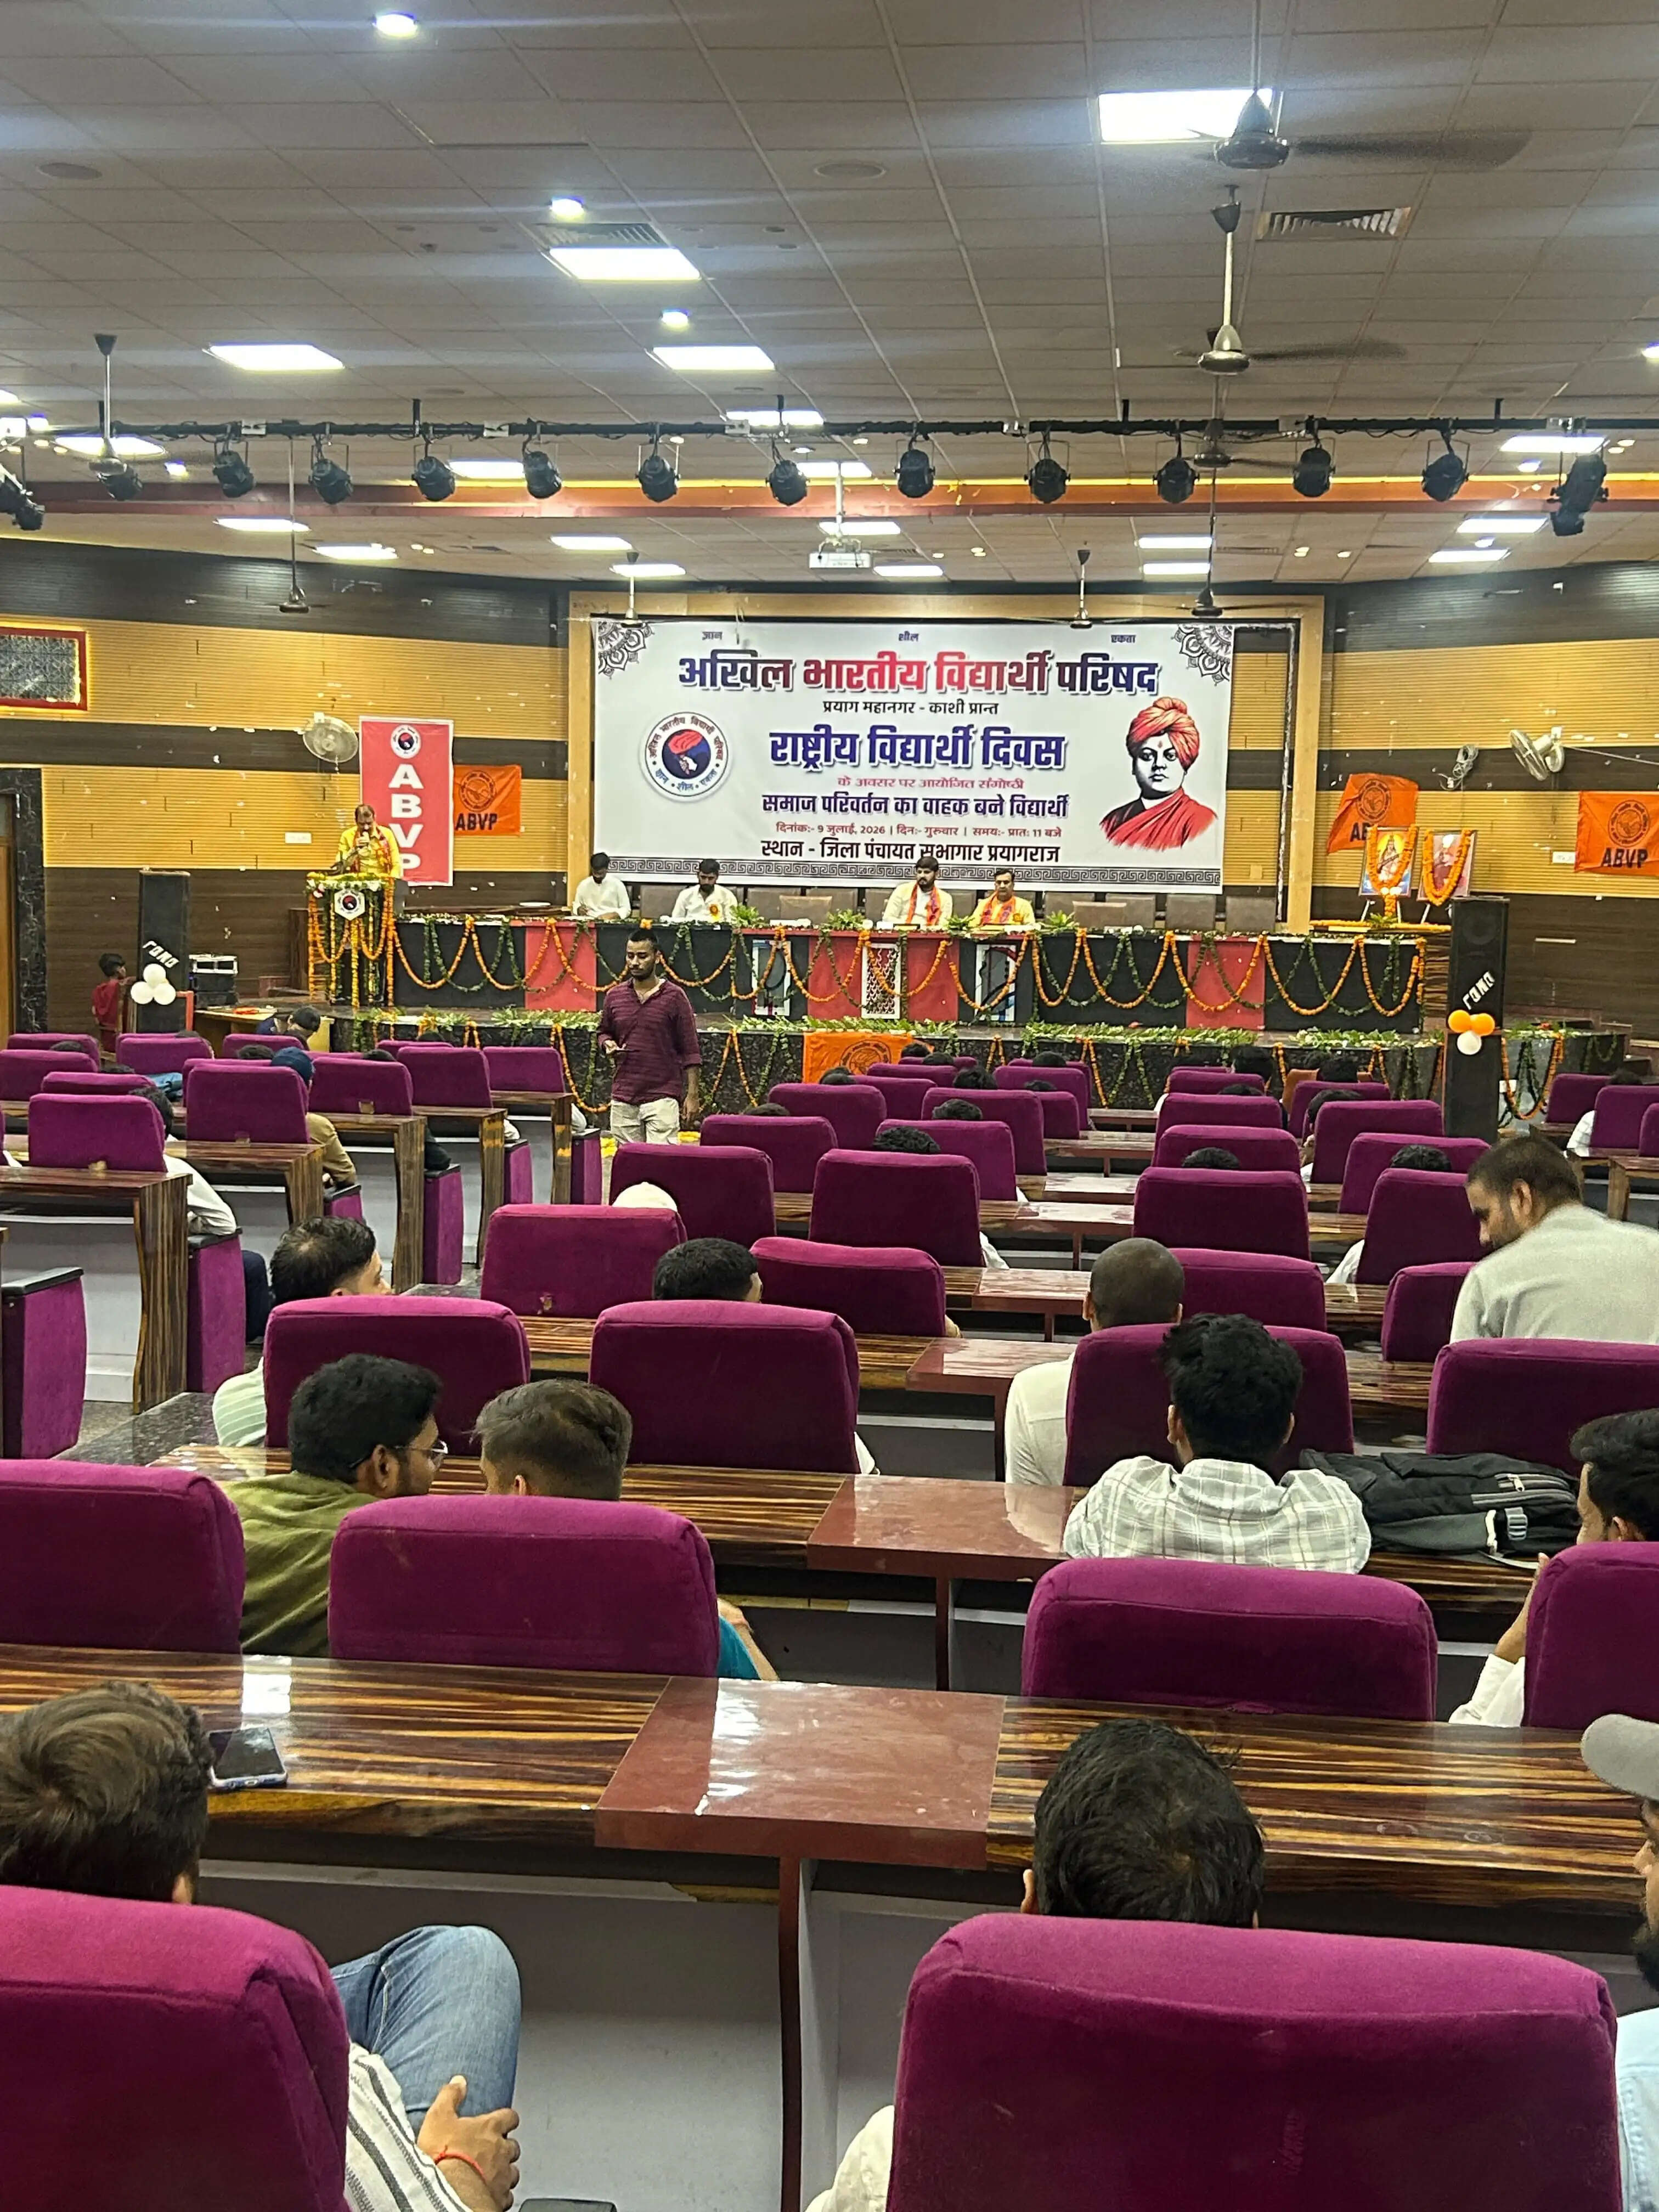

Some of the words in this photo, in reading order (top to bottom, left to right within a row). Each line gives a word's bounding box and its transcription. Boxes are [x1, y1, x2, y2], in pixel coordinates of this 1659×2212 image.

[898, 630, 919, 642] शील
[1111, 634, 1136, 644] एकता
[679, 649, 793, 689] अखिल
[803, 650, 927, 691] भारतीय
[934, 650, 1052, 692] विद्यार्थी
[1056, 653, 1159, 693] परिषद
[823, 701, 859, 714] प्रयाग
[862, 702, 915, 714] महानगर
[929, 698, 964, 714] काशी
[769, 724, 859, 769] राष्ट्रीय
[867, 724, 974, 765] विद्यार्थी
[980, 726, 1065, 766] दिवस
[837, 775, 851, 787] के
[856, 778, 896, 788] अवसर
[899, 778, 916, 788] पर
[919, 776, 975, 788] आयोजित
[762, 794, 817, 813] समाज
[822, 791, 889, 814] परिवर्तन
[894, 797, 918, 814] का
[922, 797, 970, 816] वाहक
[973, 794, 1005, 816] बने
[1009, 794, 1070, 817] विद्यार्थी
[455, 812, 498, 831] ABVP
[860, 825, 885, 834] 2026
[1033, 829, 1042, 837] 11
[1045, 826, 1062, 838] बजे
[761, 840, 804, 857] स्थान
[820, 837, 861, 859] जिला
[864, 838, 916, 860] पंचायत
[919, 843, 984, 861] सभागार
[988, 844, 1060, 862] प्रयागराज
[1601, 847, 1649, 868] ABVP
